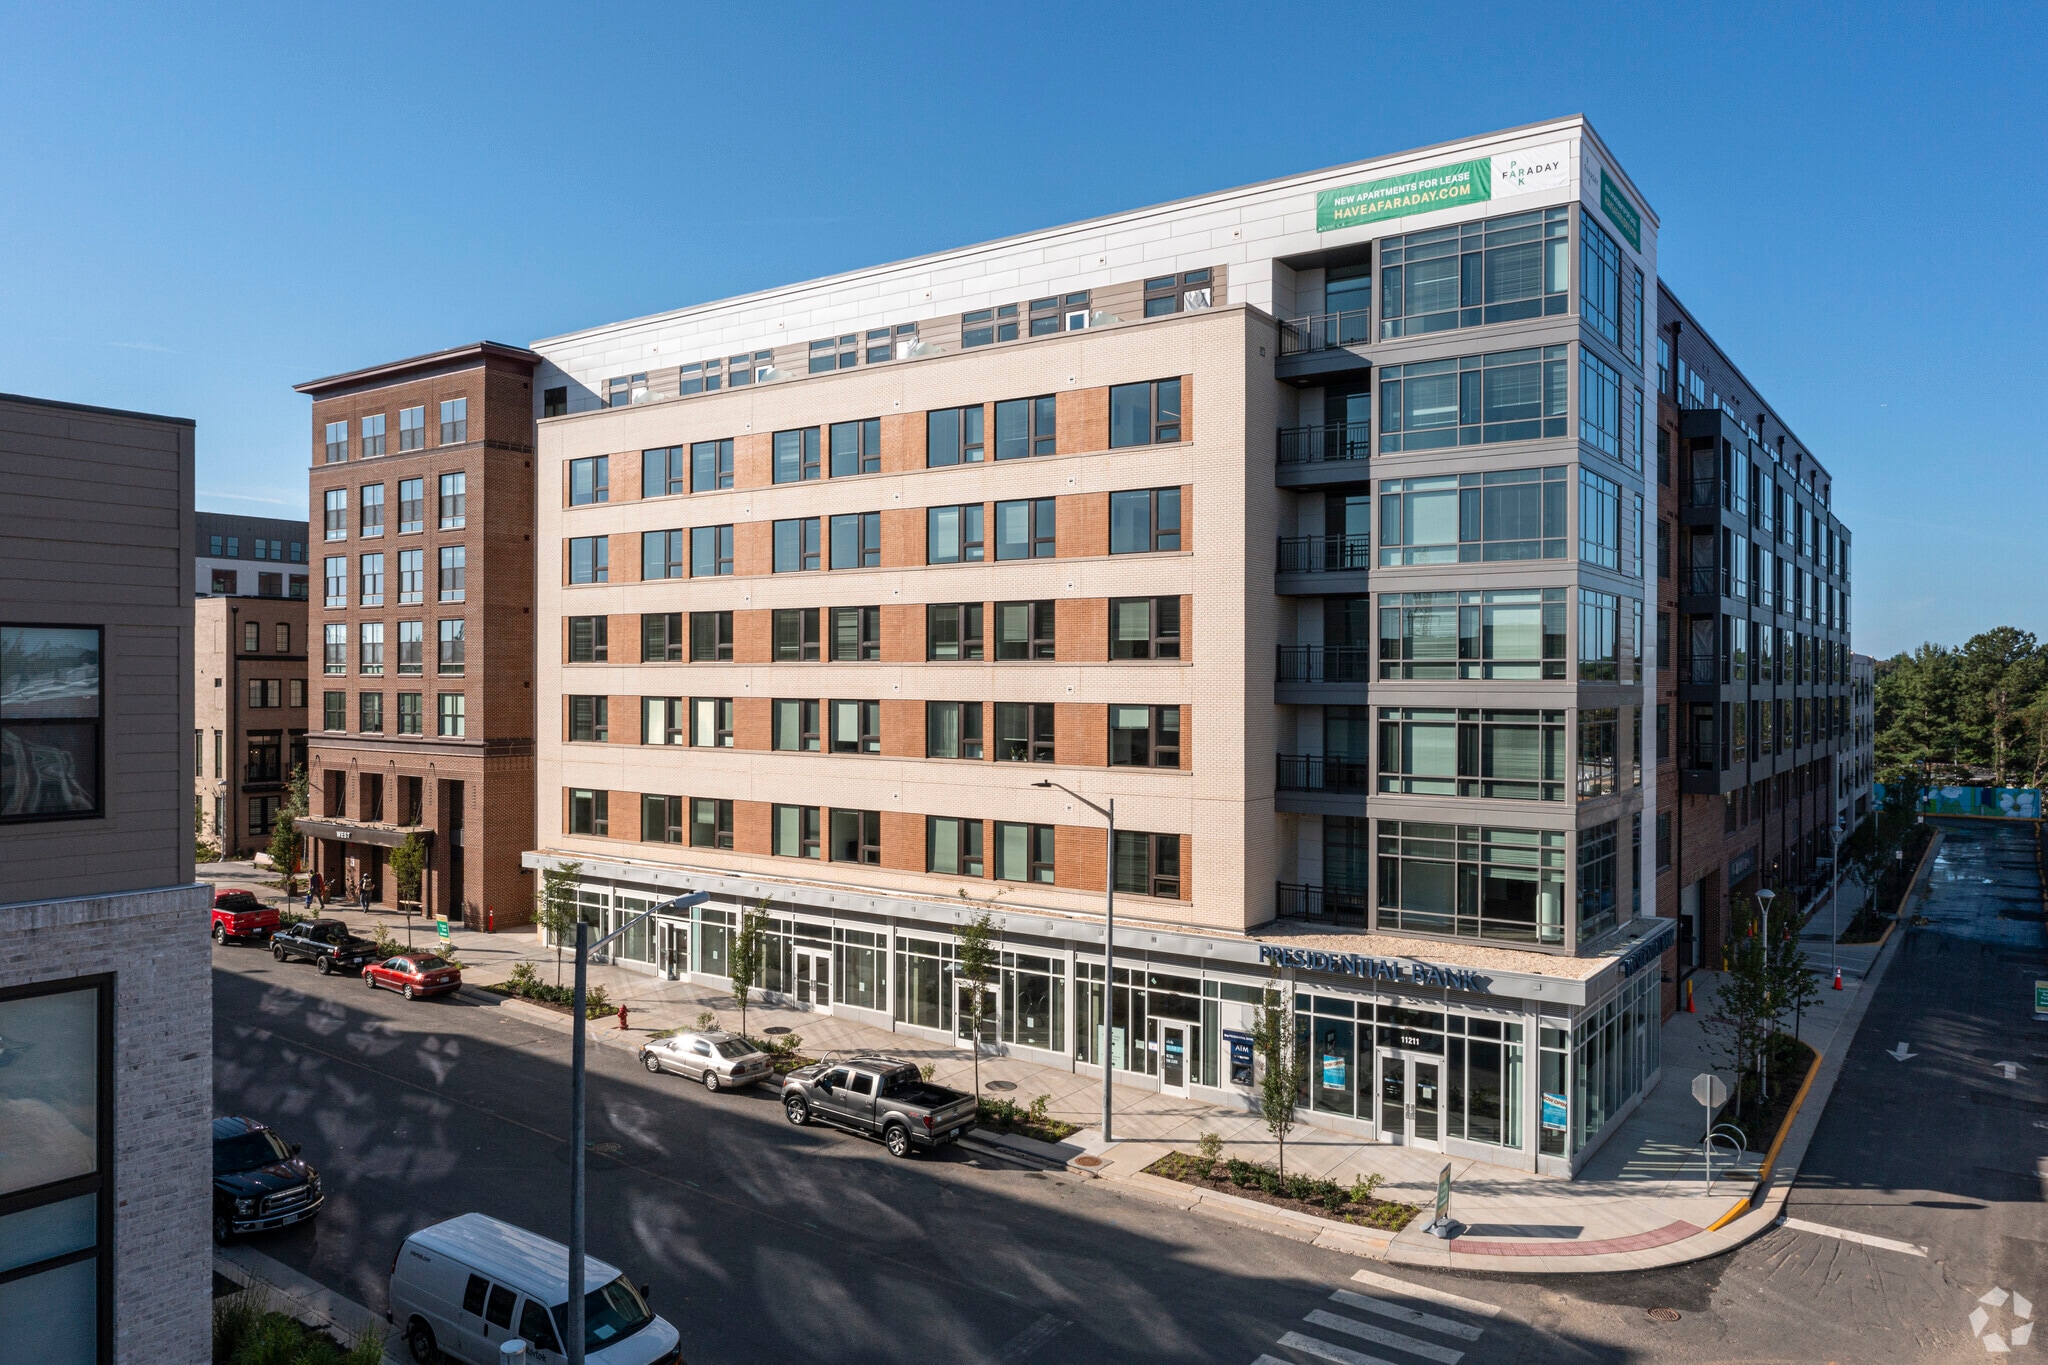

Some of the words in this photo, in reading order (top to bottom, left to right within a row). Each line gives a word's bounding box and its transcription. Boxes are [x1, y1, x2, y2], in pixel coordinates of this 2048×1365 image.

[1334, 196, 1355, 207] NEW
[1356, 181, 1417, 202] APARTMENTS
[1419, 177, 1438, 191] FOR
[1439, 171, 1471, 186] LEASE
[1333, 183, 1471, 220] HAVEAFARADAY.COM
[336, 831, 351, 839] WEST
[1258, 945, 1405, 981] PRESIDENTIAL
[1411, 963, 1481, 992] BANK
[1235, 1044, 1249, 1053] ATM
[1401, 1036, 1420, 1045] 11211
